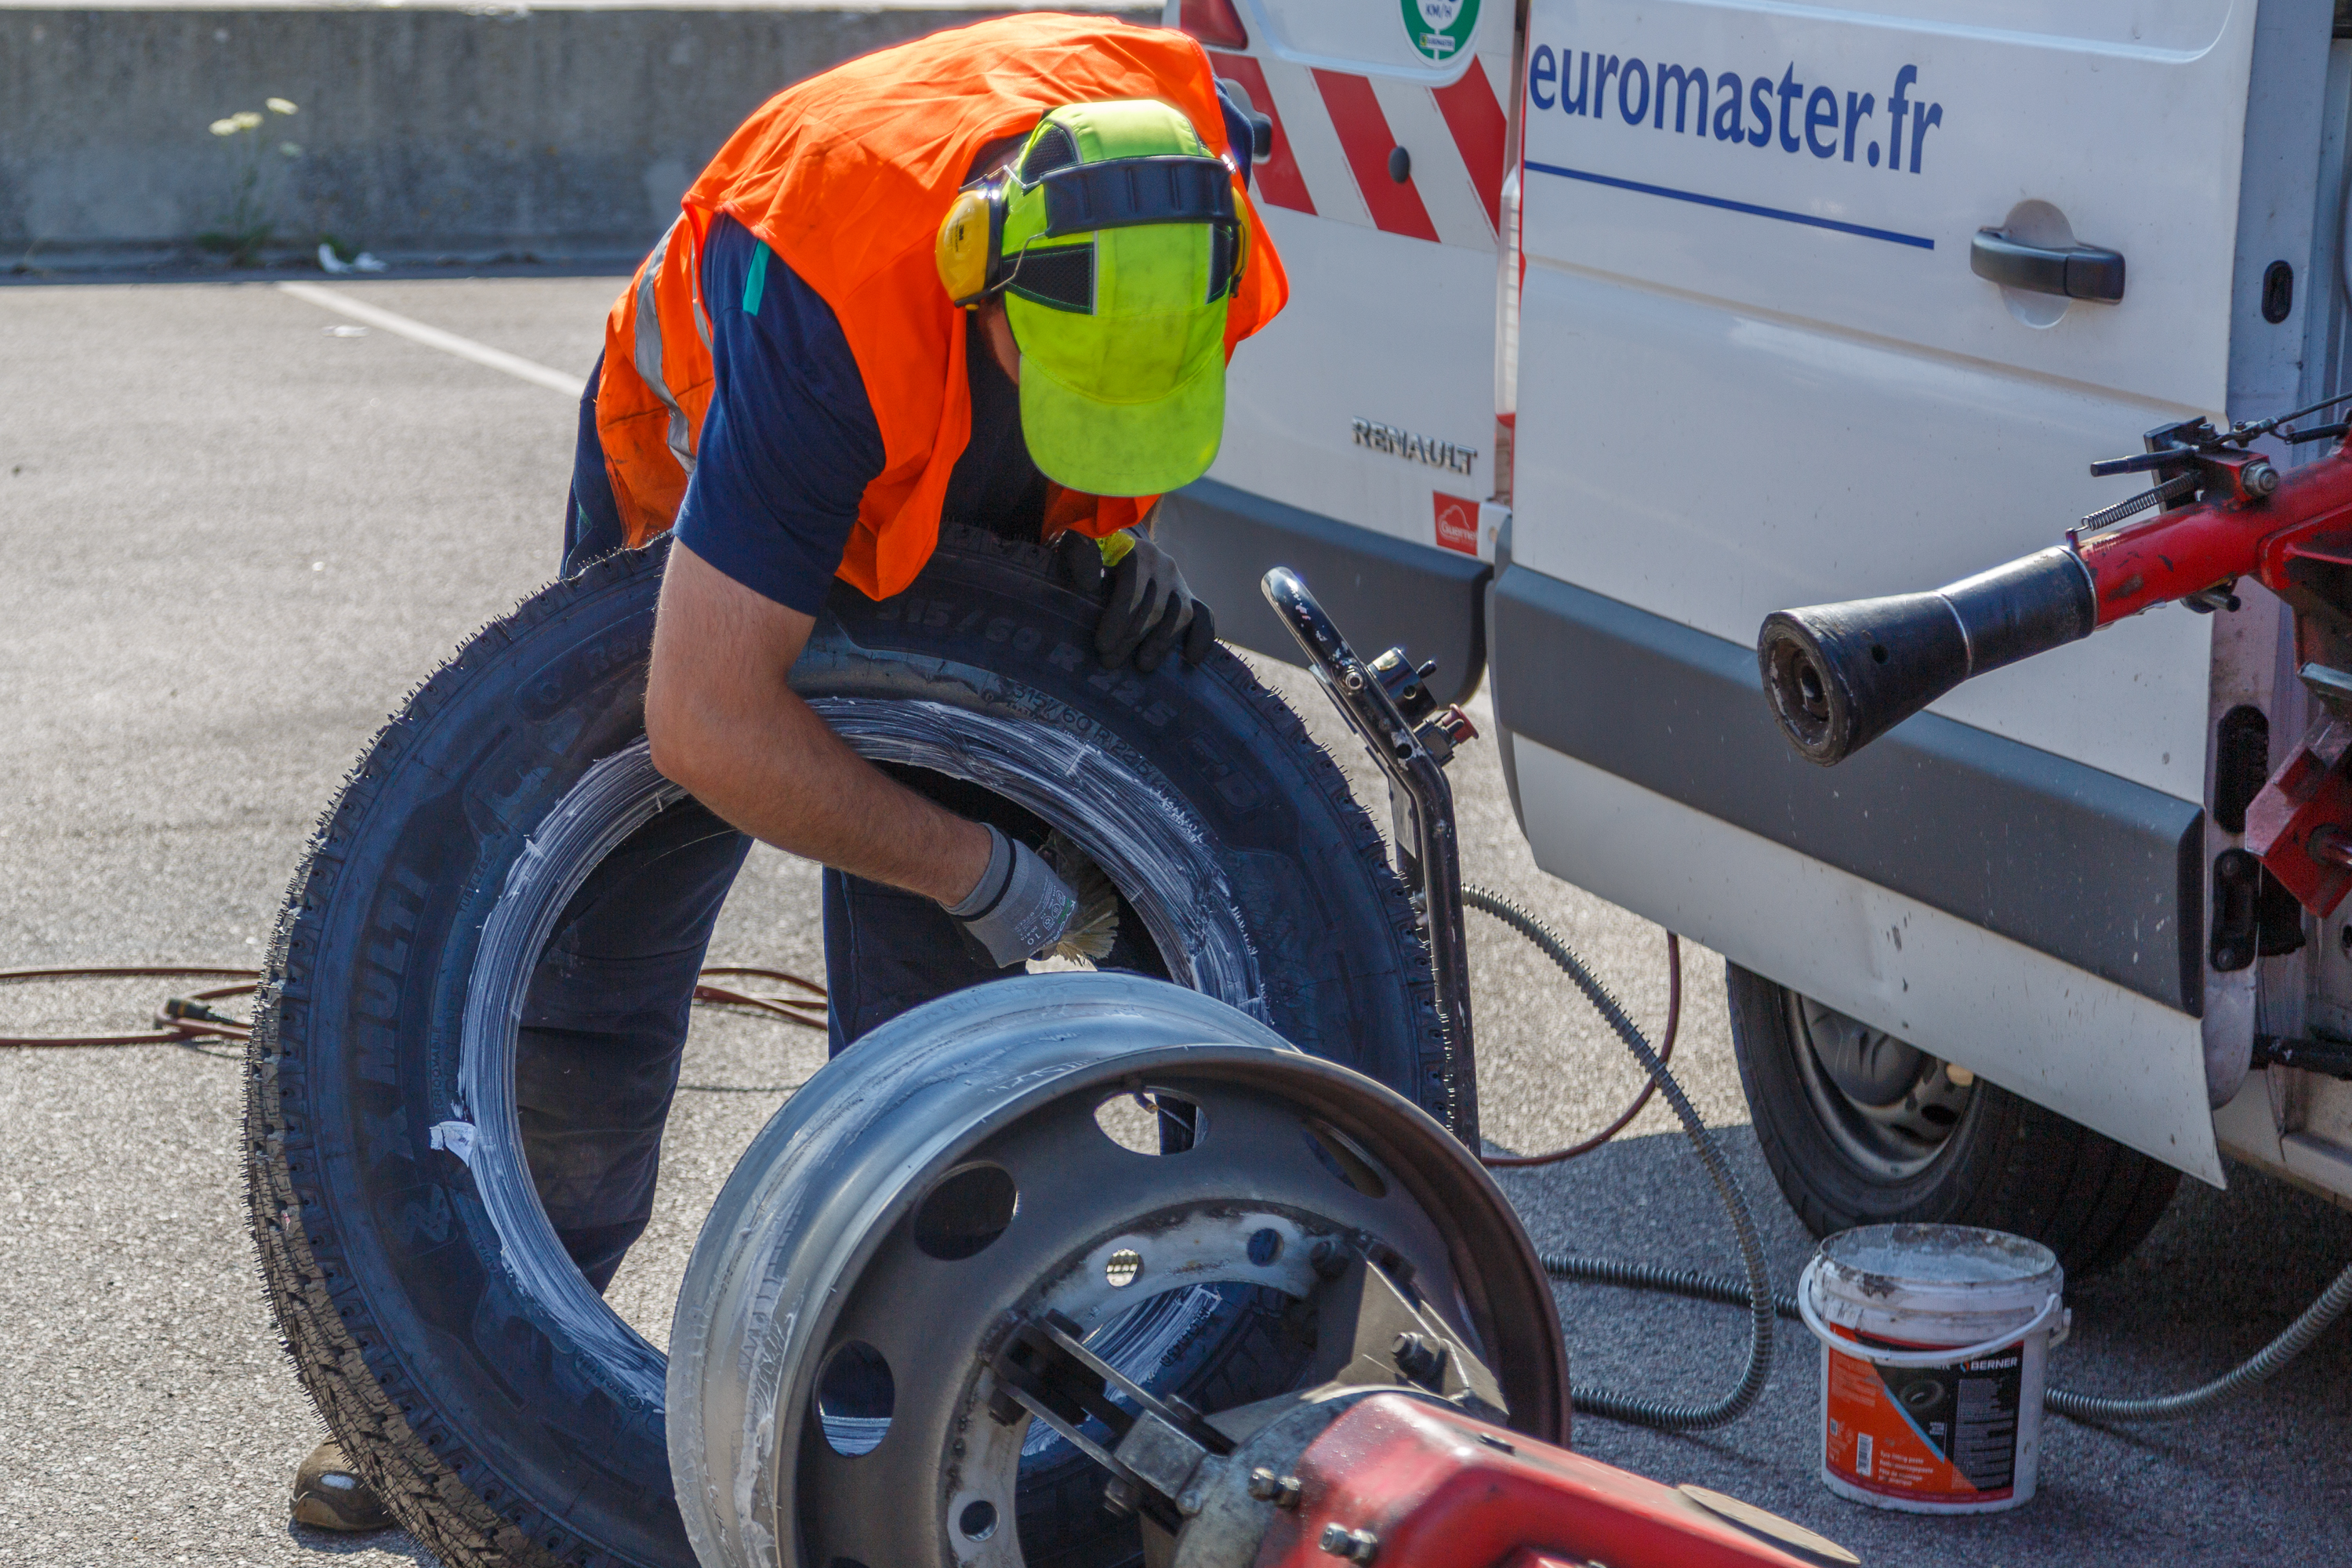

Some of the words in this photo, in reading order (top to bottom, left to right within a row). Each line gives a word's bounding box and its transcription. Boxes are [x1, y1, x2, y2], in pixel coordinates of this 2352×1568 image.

[1425, 3, 1453, 20] KM/H
[1530, 43, 1944, 174] euromaster.fr
[1352, 416, 1478, 475] RENAULT
[459, 852, 493, 913] TUBELESS
[1027, 933, 1041, 946] 10
[358, 863, 429, 1085] MULTI
[1971, 1356, 2017, 1371] BERNER
